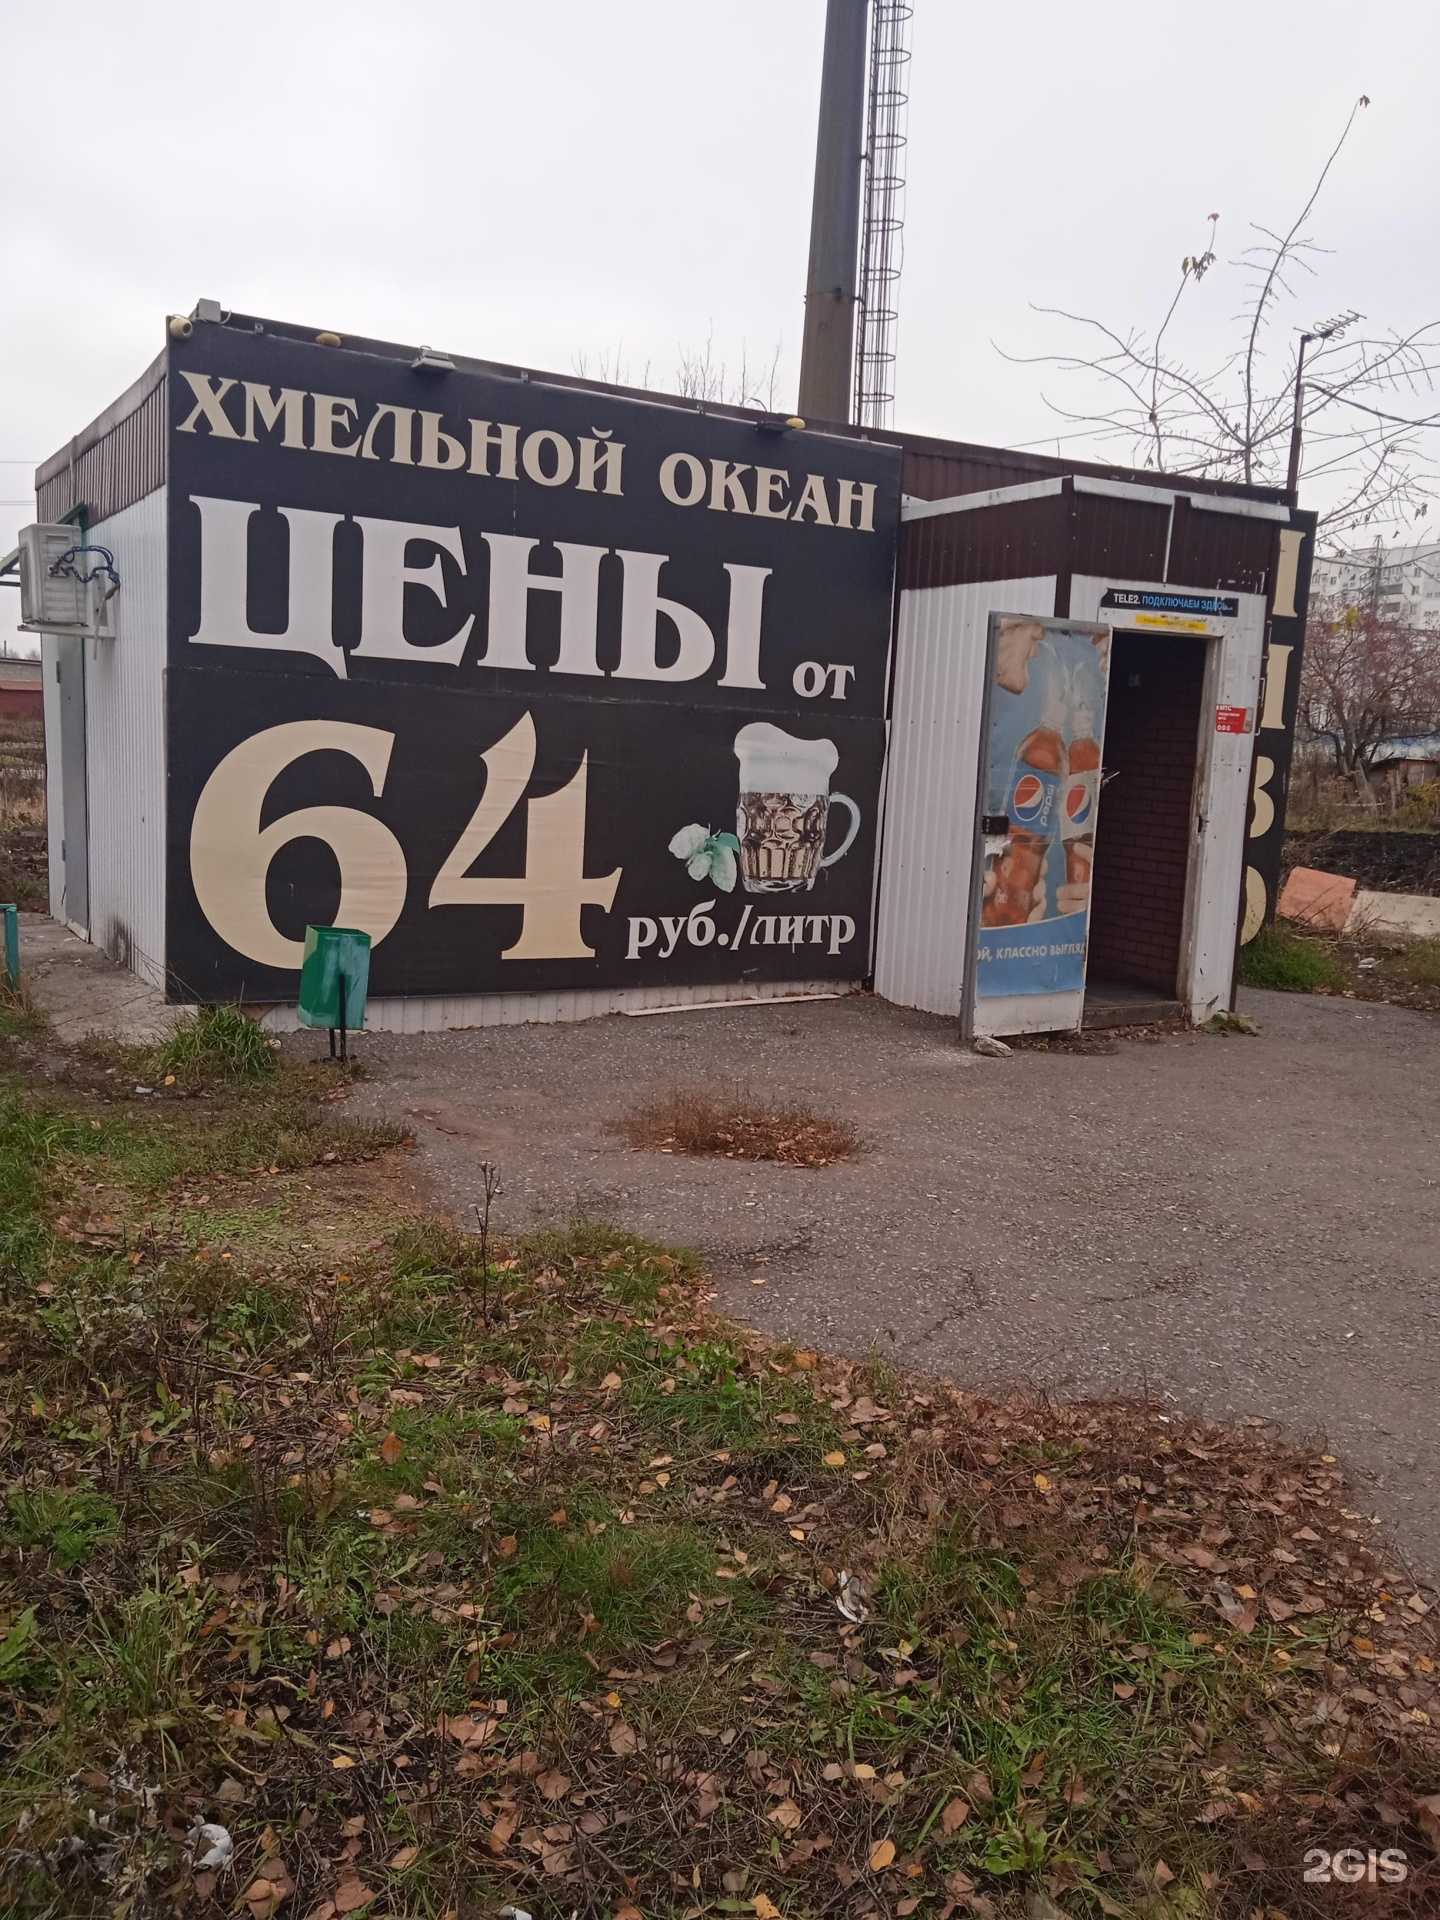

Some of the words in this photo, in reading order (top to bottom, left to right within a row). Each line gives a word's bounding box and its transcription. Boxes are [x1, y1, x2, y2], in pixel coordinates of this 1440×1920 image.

[177, 370, 626, 497] ХМЕЛЬНОЙ
[659, 452, 878, 532] ОКЕАН
[188, 495, 773, 690] ЦЕНЫ
[792, 660, 856, 701] от
[1142, 594, 1200, 609] ПОДКЛЮЧАЕМ
[1040, 784, 1056, 827] pepsi
[190, 709, 623, 970] 64
[625, 899, 856, 960] руб./литр
[995, 945, 1048, 961] КЛАССНО
